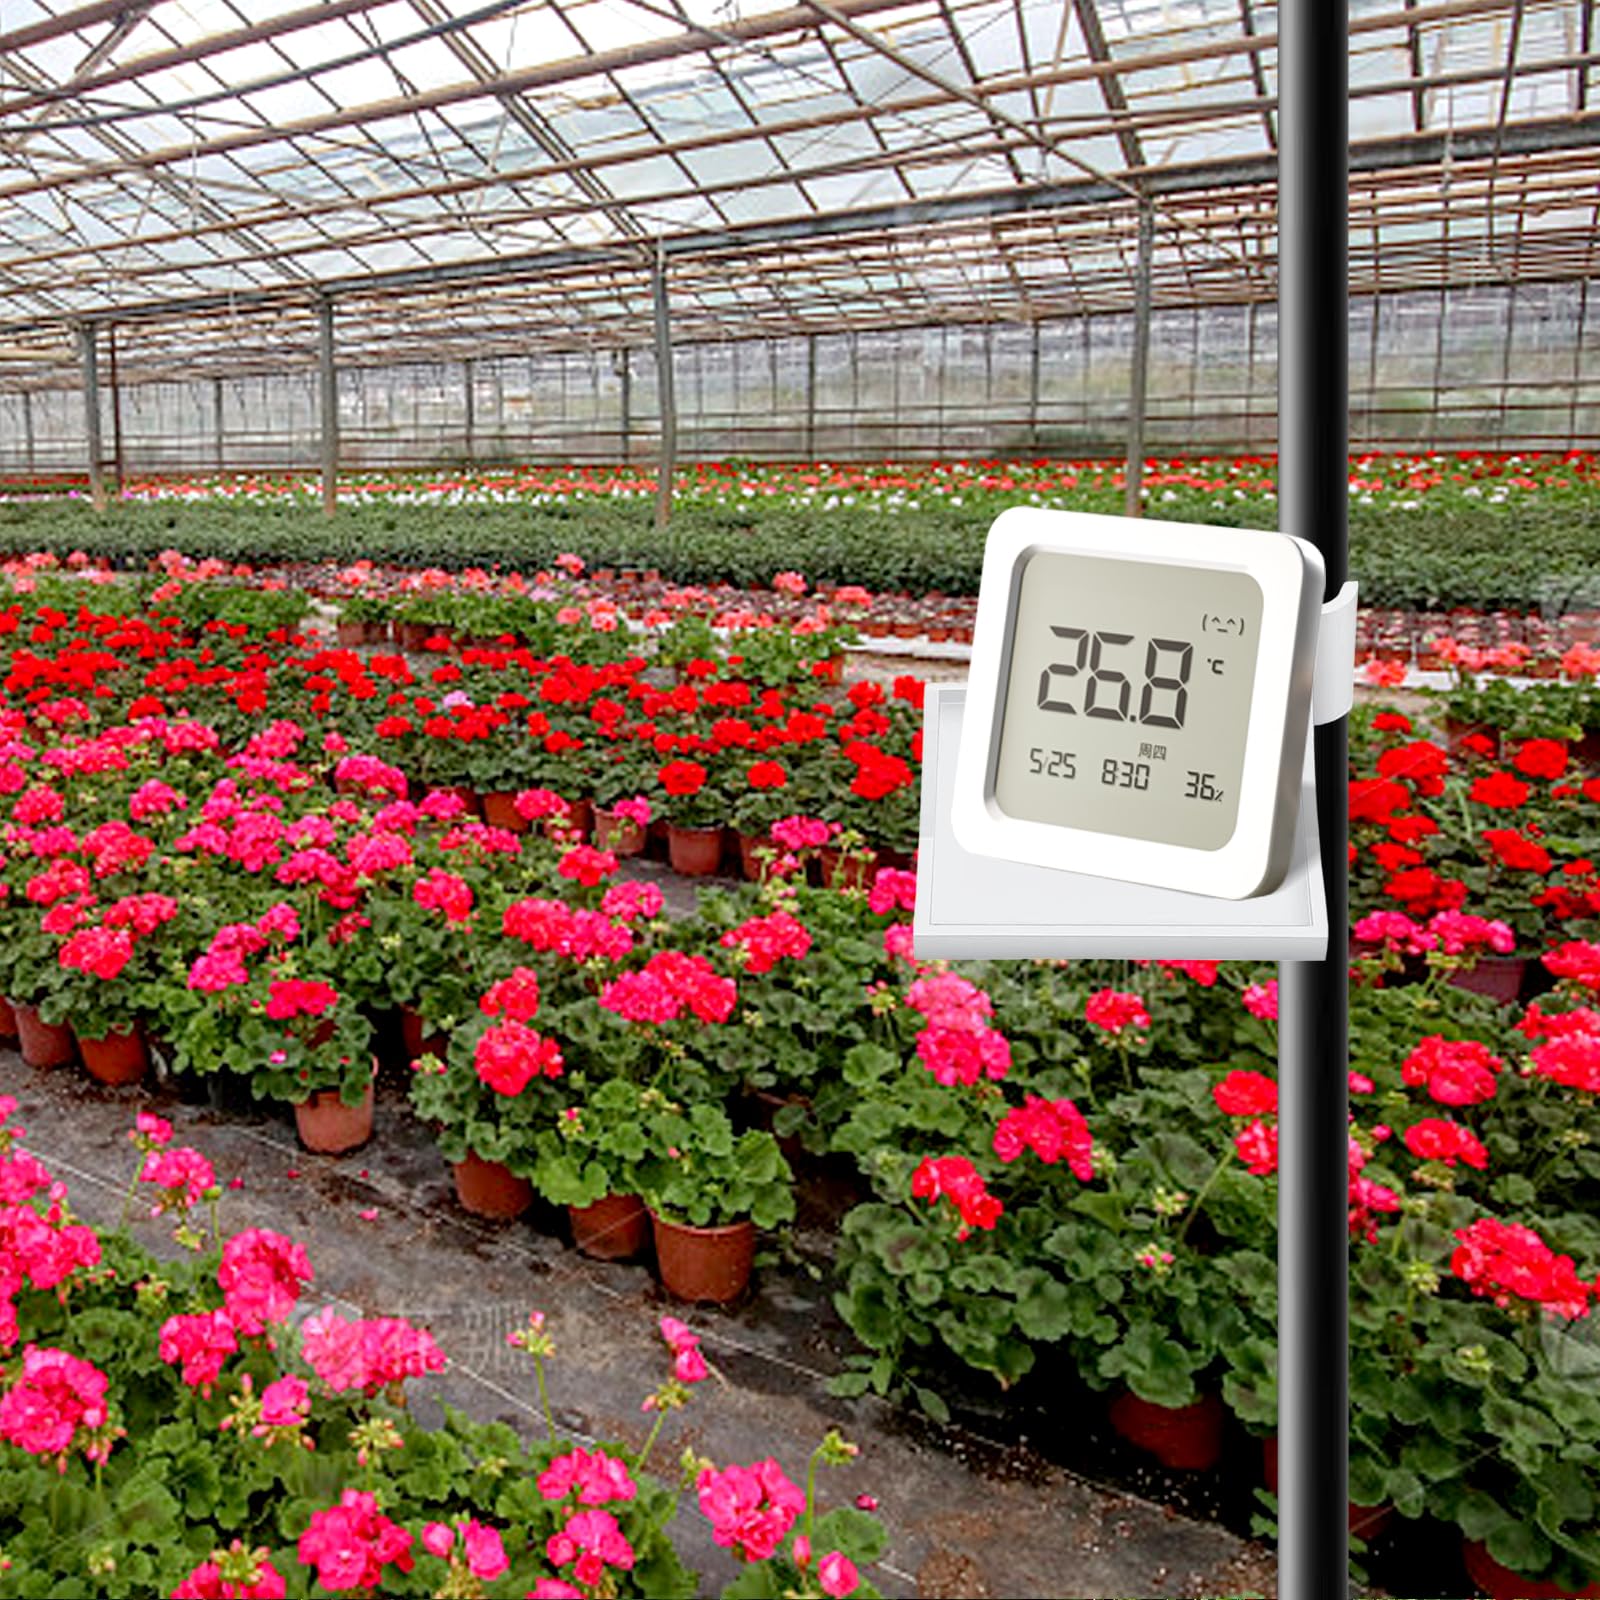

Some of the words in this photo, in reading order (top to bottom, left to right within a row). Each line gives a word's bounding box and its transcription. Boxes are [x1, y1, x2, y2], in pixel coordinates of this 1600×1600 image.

[1037, 626, 1193, 730] 26.8
[1138, 742, 1167, 760] 周四
[1184, 771, 1224, 802] 36%
